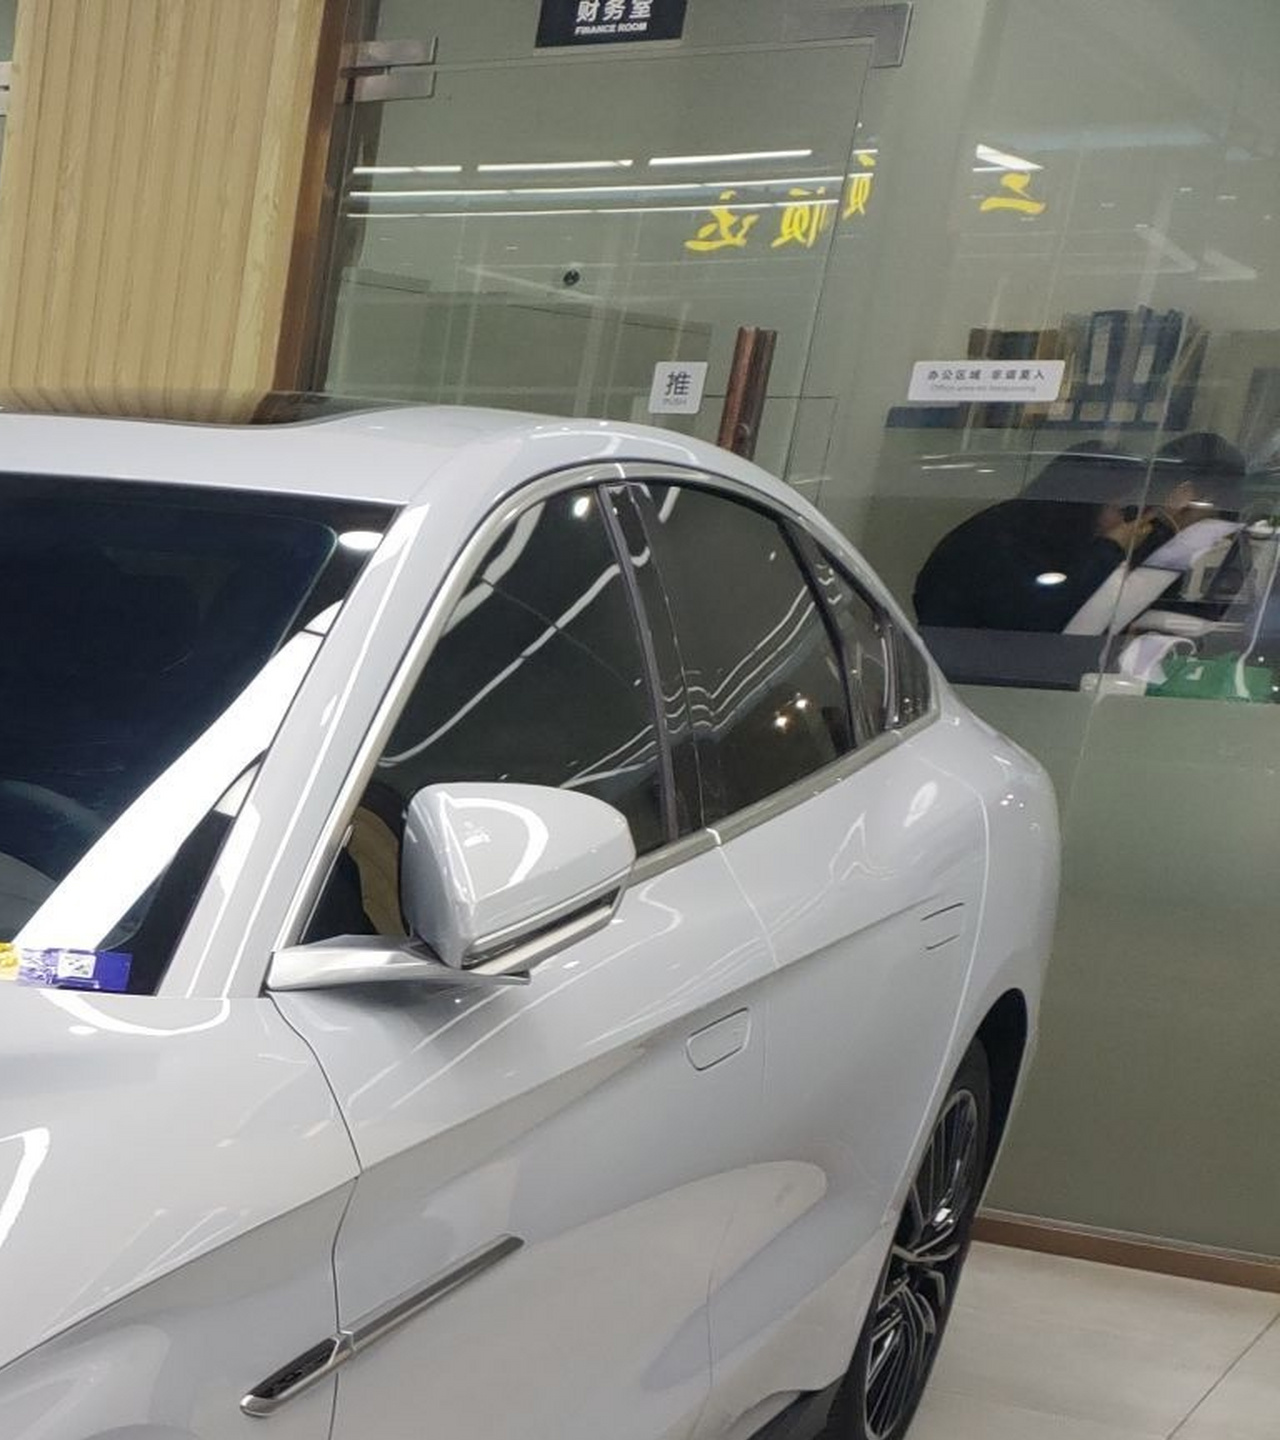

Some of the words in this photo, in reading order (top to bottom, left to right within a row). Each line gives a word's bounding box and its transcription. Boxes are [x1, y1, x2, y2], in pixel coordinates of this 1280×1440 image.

[576, 0, 652, 23] 财务室
[575, 25, 617, 35] FINANCE
[618, 22, 647, 32] ROOM
[666, 371, 691, 396] 推
[928, 370, 981, 380] 办公区域
